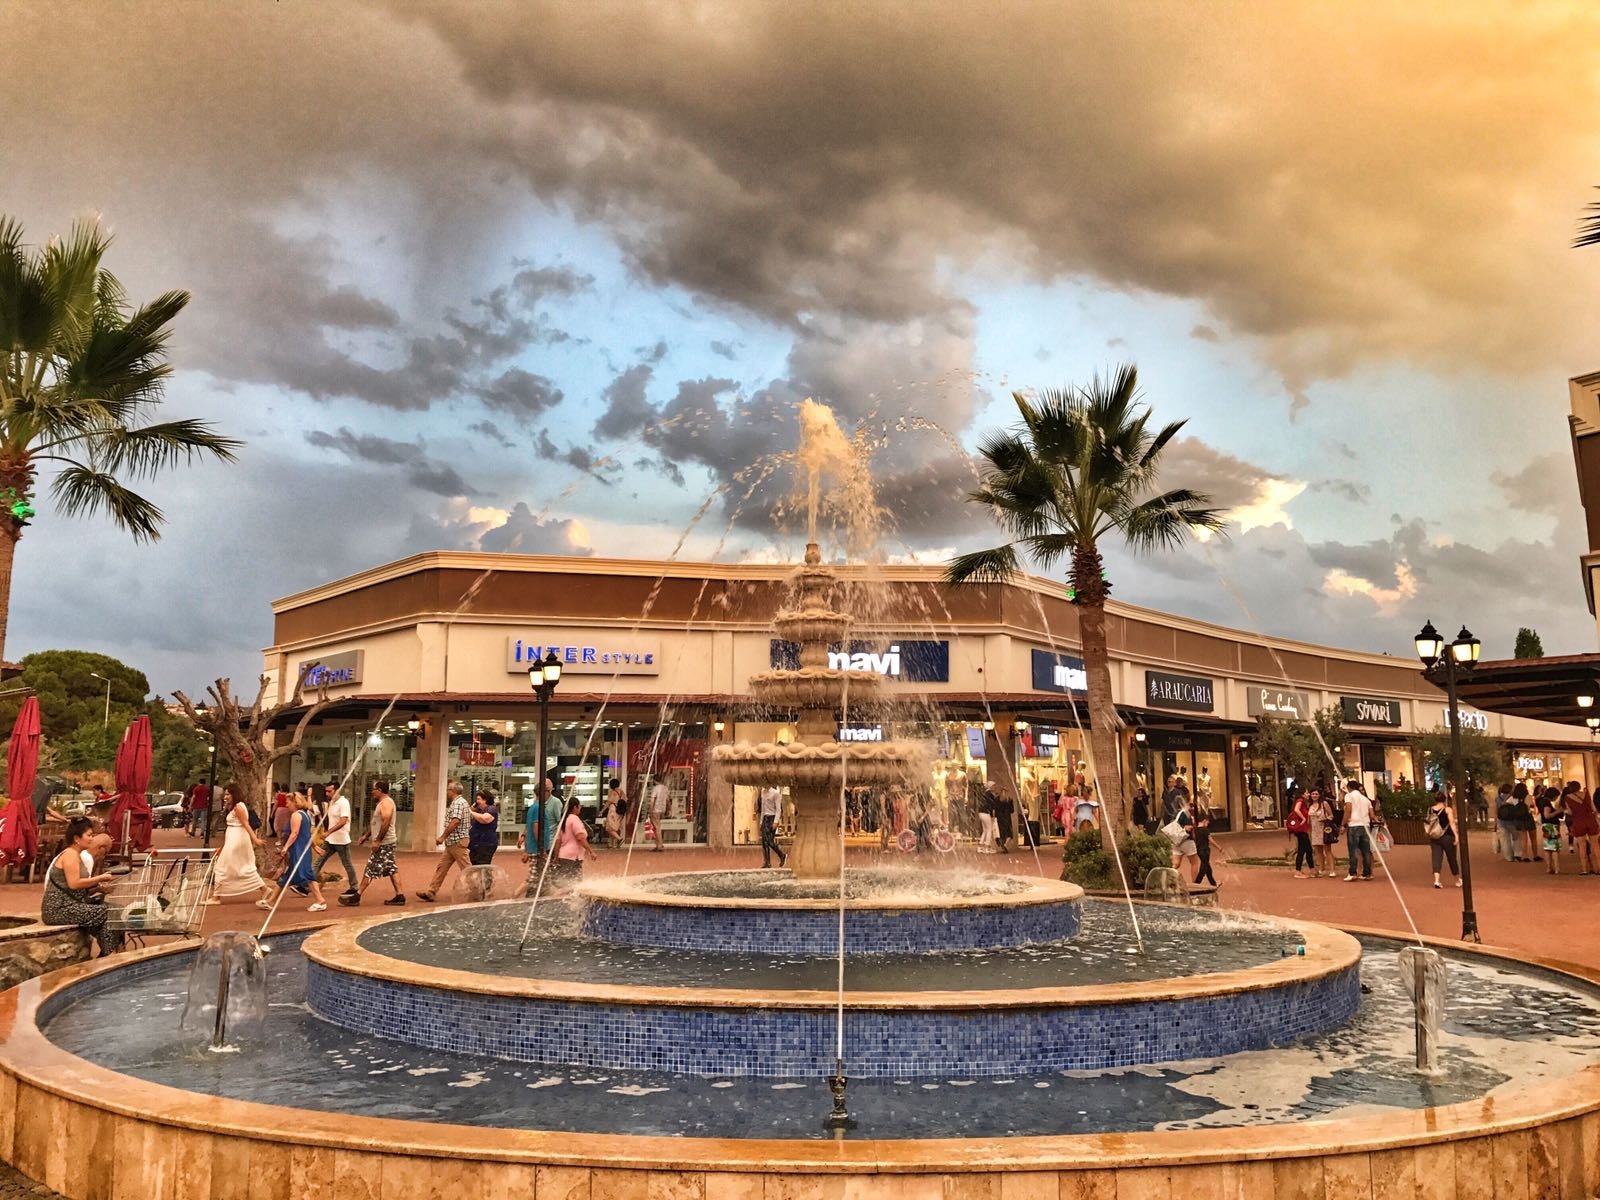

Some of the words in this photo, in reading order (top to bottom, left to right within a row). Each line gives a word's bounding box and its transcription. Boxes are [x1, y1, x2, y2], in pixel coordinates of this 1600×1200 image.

[601, 653, 653, 664] STYLE
[1159, 681, 1212, 704] ARAUCARIA
[840, 724, 881, 741] mavi
